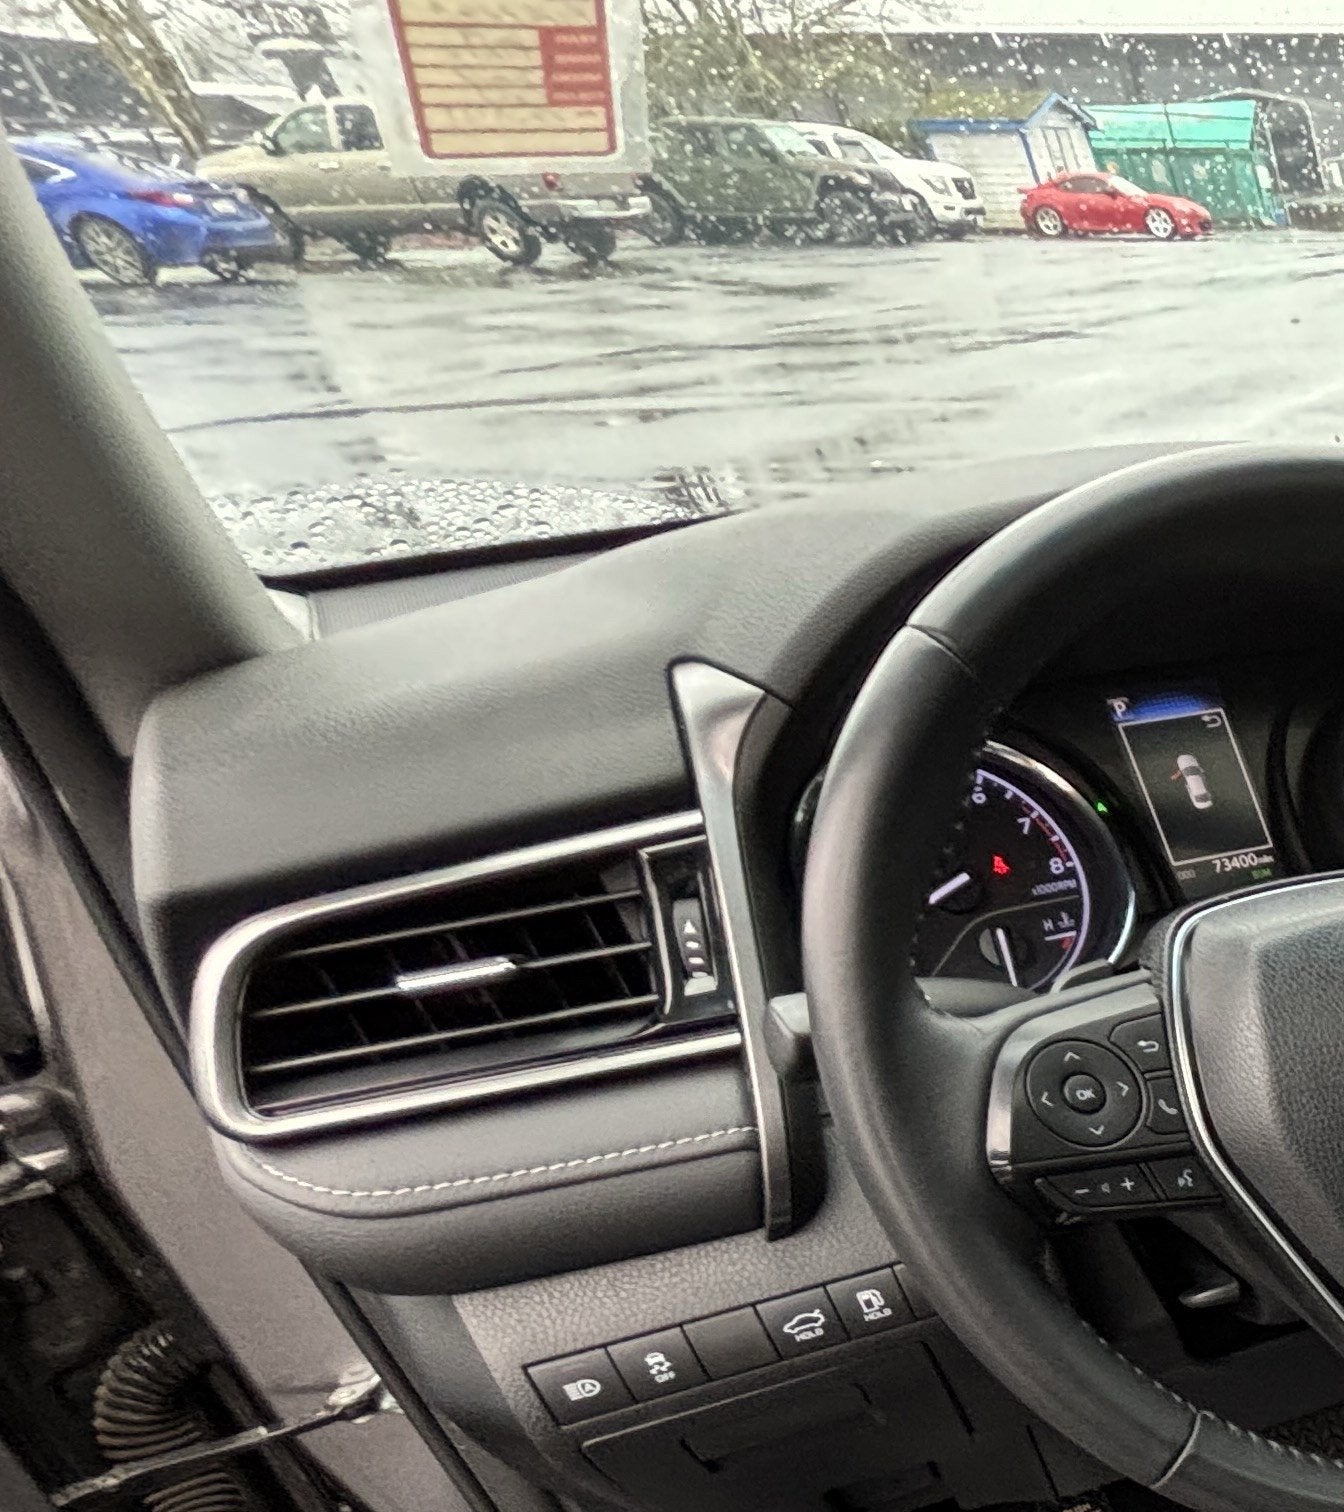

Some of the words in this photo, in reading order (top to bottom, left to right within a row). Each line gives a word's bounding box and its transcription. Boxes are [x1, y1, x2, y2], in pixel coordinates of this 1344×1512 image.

[1017, 816, 1031, 835] 7
[1050, 857, 1065, 875] 8
[1211, 852, 1258, 874] 73400
[1075, 1088, 1098, 1102] OK
[864, 1307, 893, 1322] HOLD
[794, 1326, 825, 1342] HOLD
[654, 1370, 677, 1384] OFF
